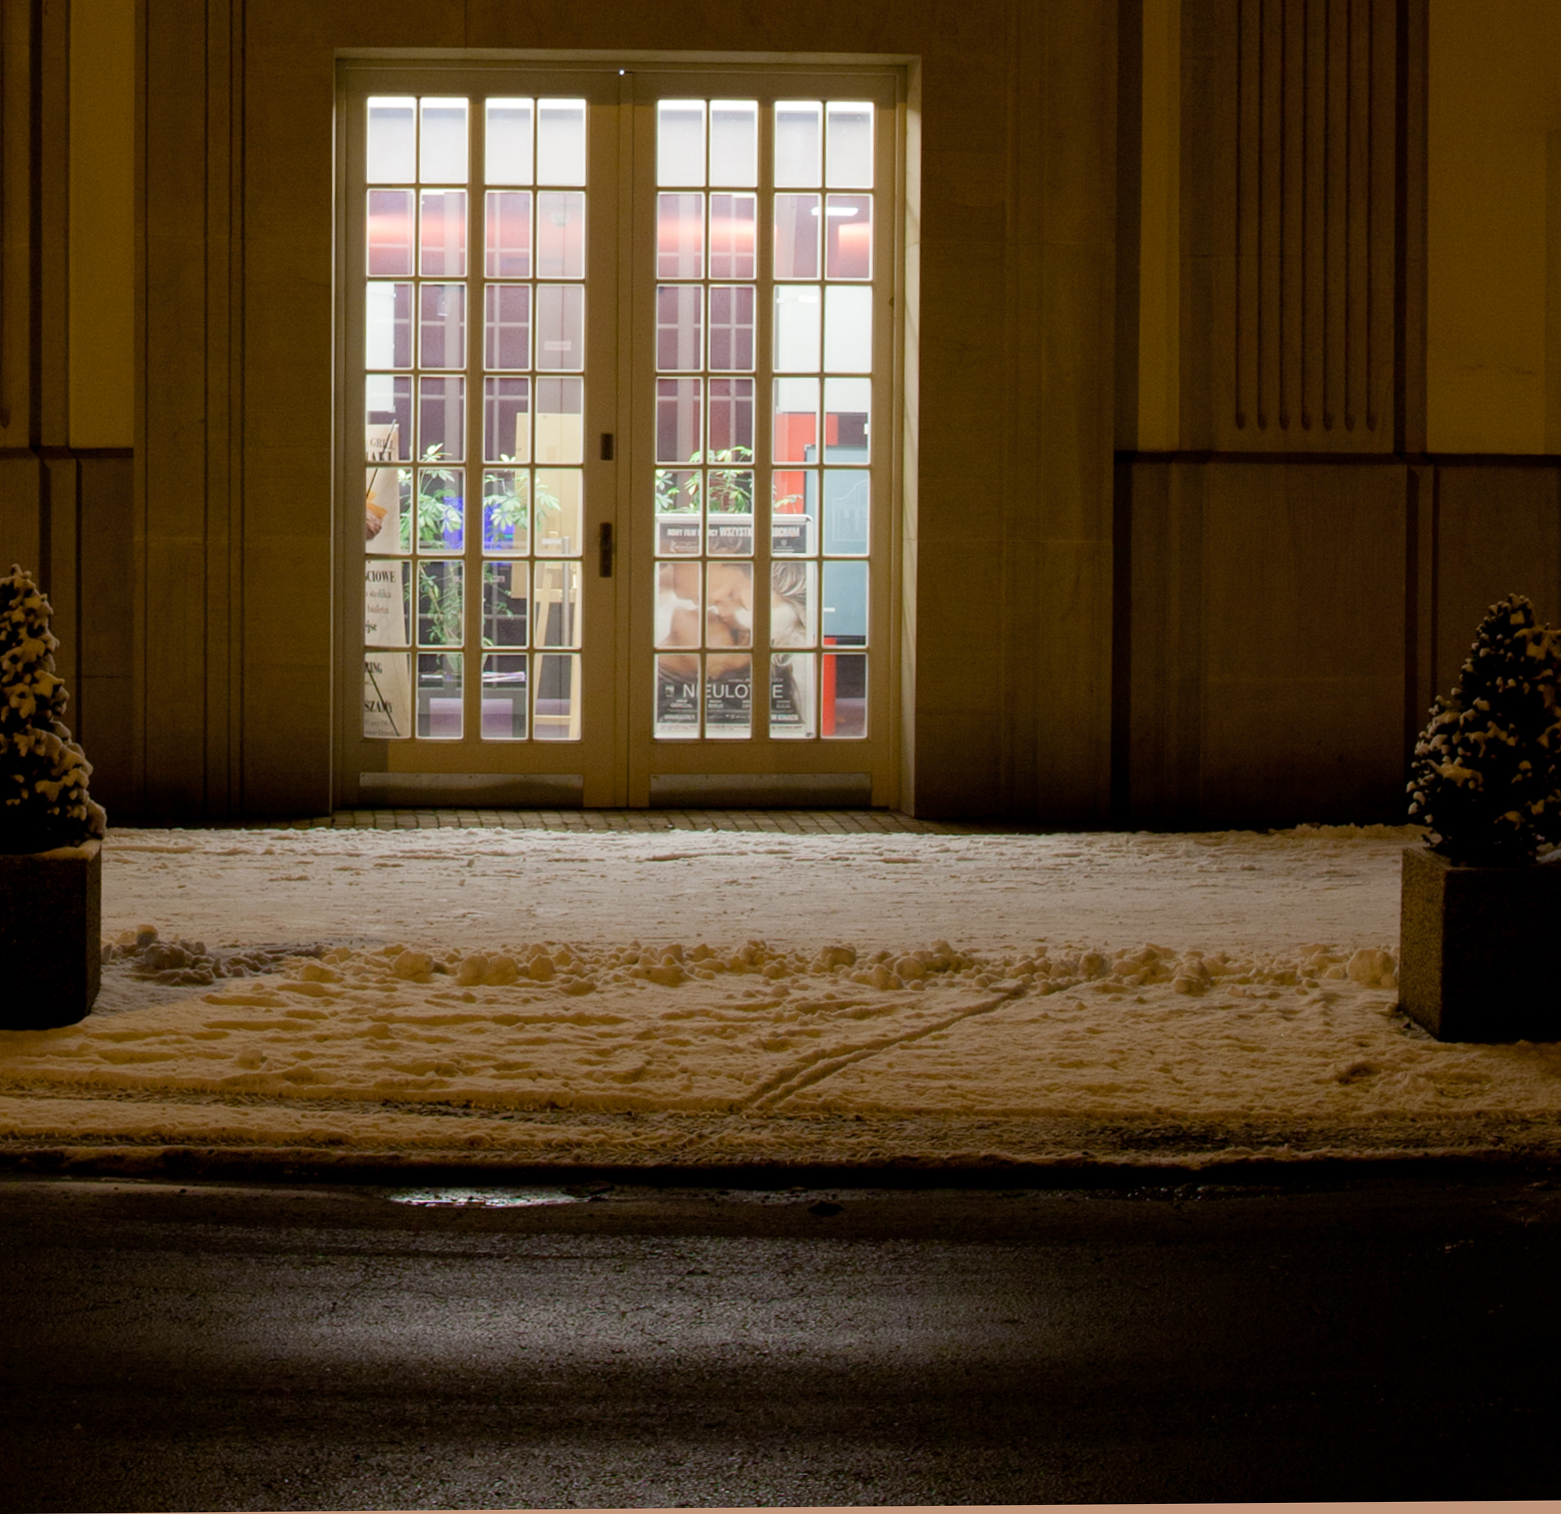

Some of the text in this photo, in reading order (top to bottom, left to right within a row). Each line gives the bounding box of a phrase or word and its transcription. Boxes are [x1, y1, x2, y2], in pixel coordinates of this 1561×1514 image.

[370, 438, 395, 450] GRIL
[719, 526, 753, 537] WSZYST
[683, 683, 783, 698] NIEULOE
